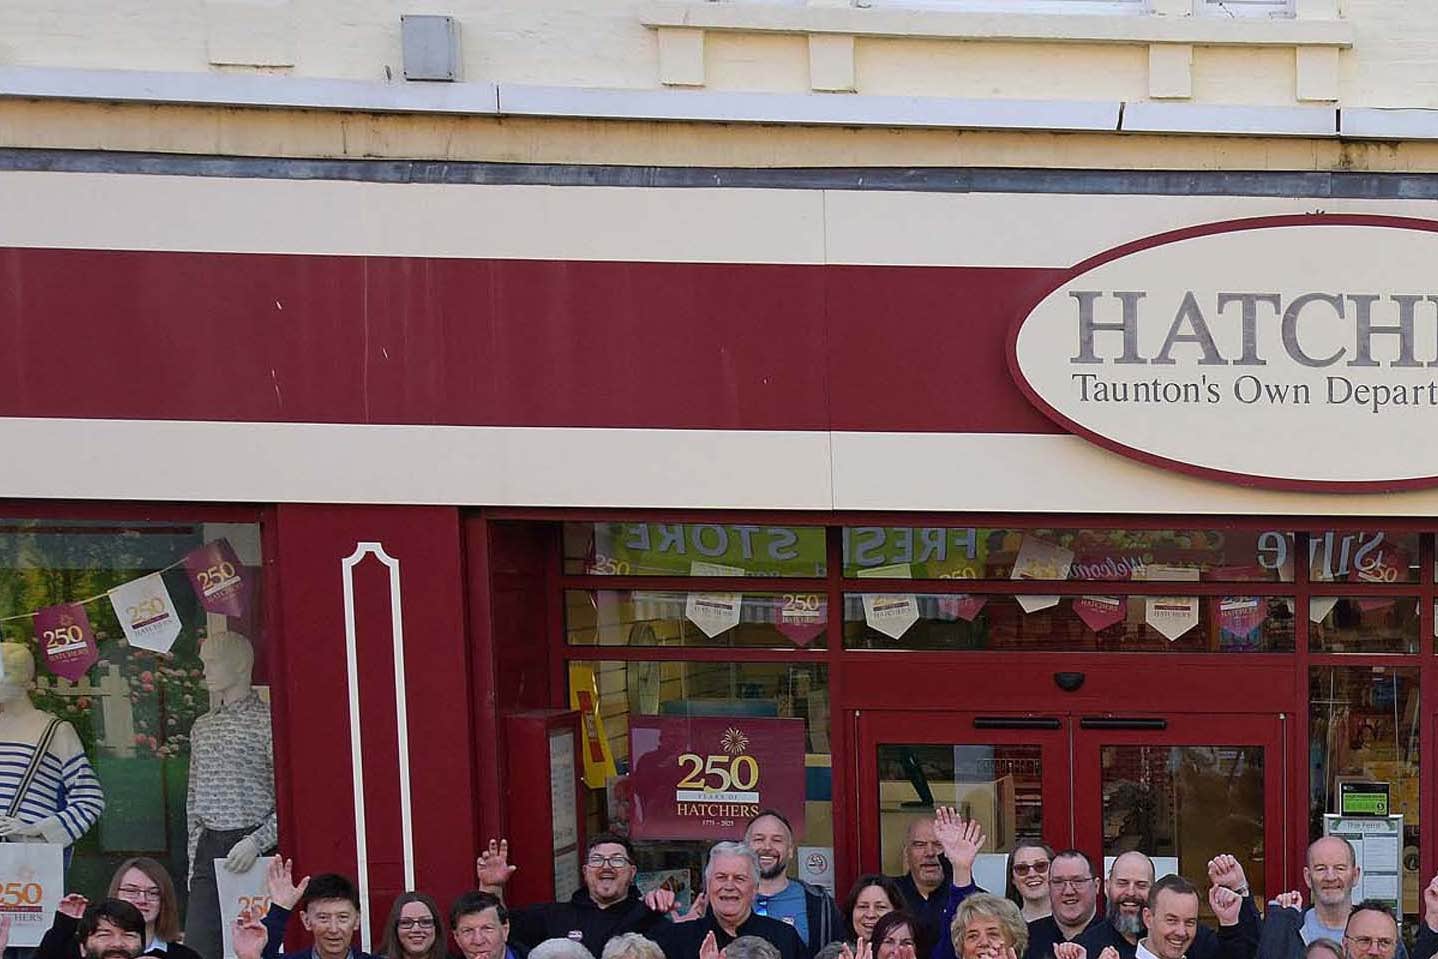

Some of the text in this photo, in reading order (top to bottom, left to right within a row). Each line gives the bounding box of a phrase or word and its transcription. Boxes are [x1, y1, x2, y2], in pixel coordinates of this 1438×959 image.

[1072, 374, 1220, 404] Taunton's
[1235, 375, 1310, 404] Own
[198, 561, 235, 589] 250
[783, 595, 819, 611] 250
[43, 625, 83, 649] 250
[677, 754, 759, 793] 250
[677, 804, 760, 817] HATCHERS
[0, 882, 43, 908] 50
